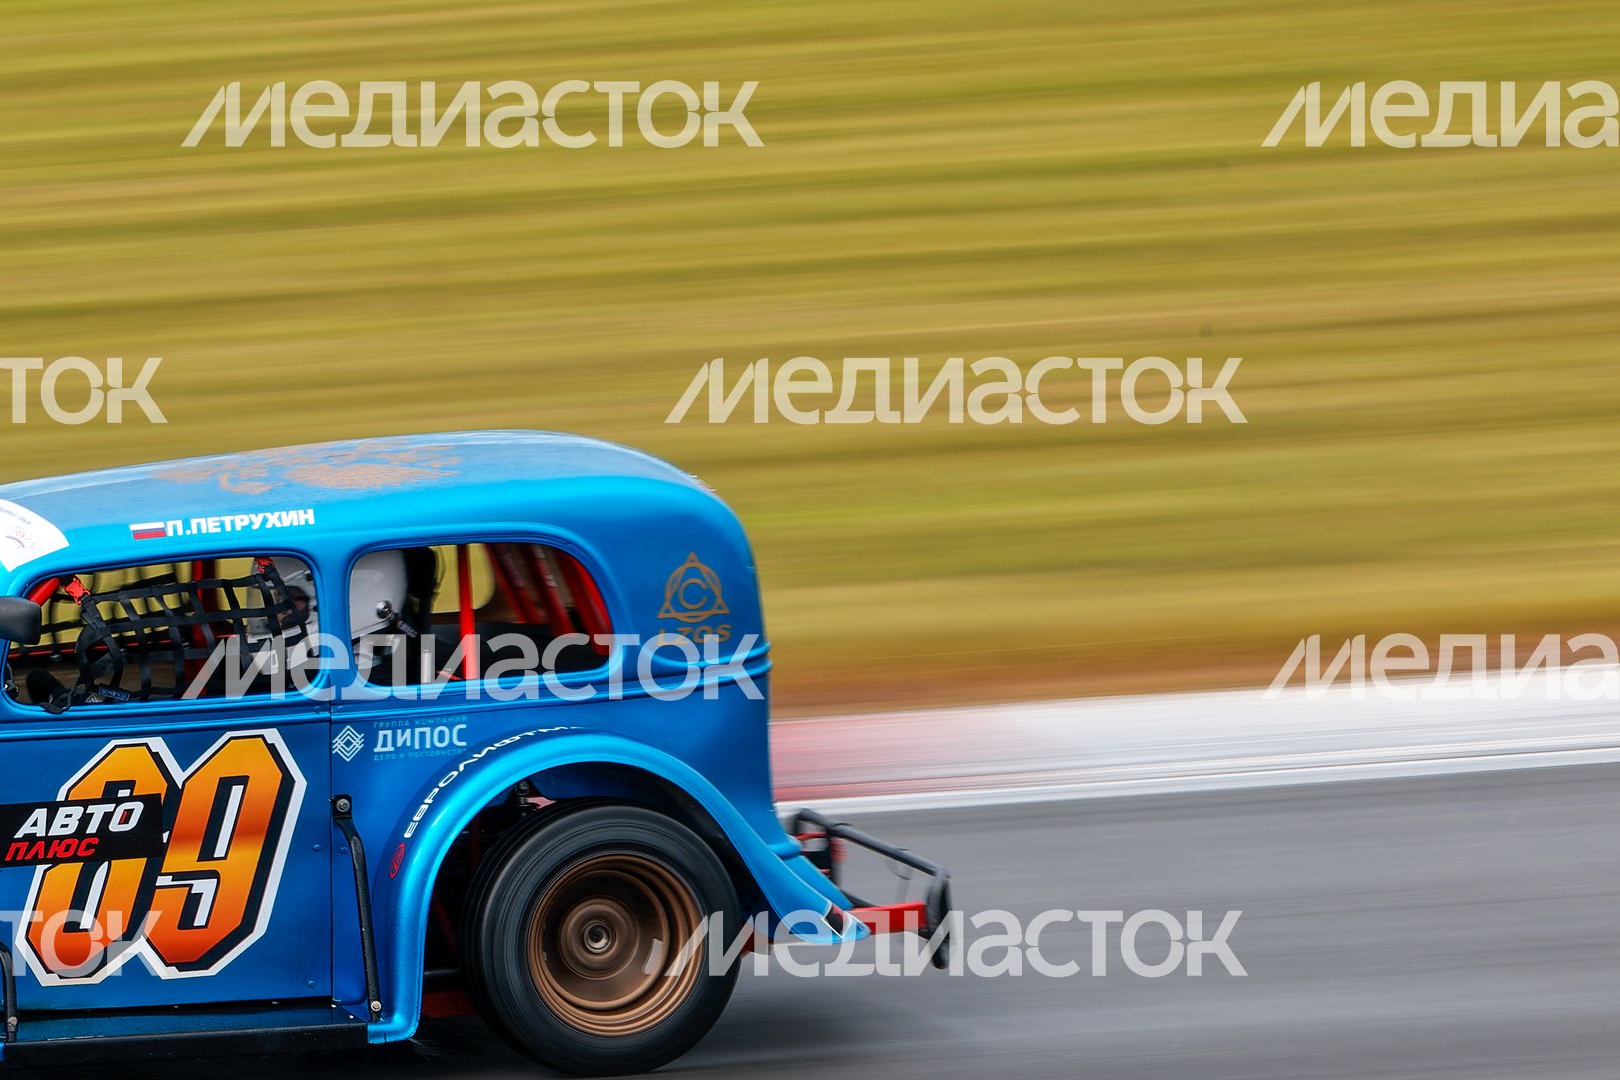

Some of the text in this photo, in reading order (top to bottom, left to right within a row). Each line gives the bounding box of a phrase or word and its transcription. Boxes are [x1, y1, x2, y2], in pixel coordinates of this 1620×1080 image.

[167, 508, 315, 536] П.ПЕТРУХИН
[373, 724, 467, 752] ДИПОС
[14, 801, 144, 839] АВТО
[5, 837, 99, 861] ПЛЮС
